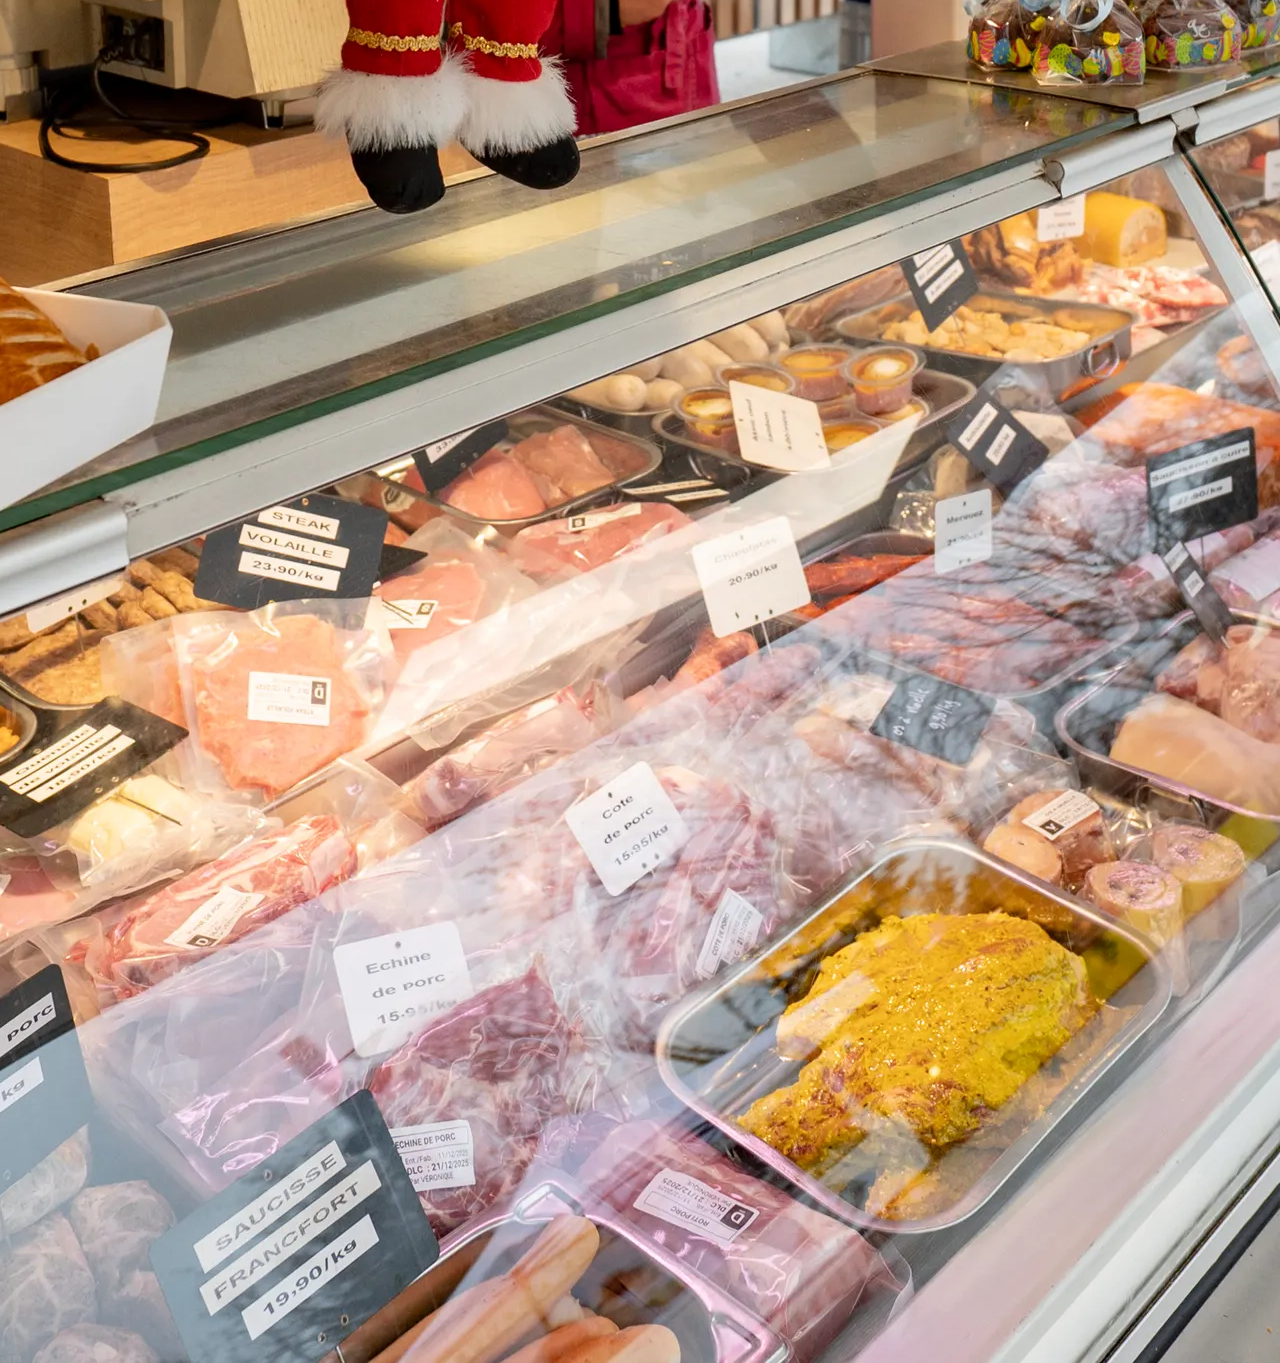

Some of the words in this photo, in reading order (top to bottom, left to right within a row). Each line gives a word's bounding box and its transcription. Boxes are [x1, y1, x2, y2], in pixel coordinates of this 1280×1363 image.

[272, 511, 332, 533] STEAK
[247, 530, 333, 559] VOLAILLE
[602, 793, 634, 820] Cote
[604, 827, 621, 845] de
[624, 805, 655, 831] porc
[365, 950, 432, 975] Echine
[372, 984, 397, 999] de
[402, 972, 446, 992] porc
[7, 1003, 54, 1042] porc
[395, 1137, 423, 1151] ECHINE
[424, 1136, 434, 1145] DE
[435, 1132, 456, 1143] PORC
[431, 1159, 470, 1171] 21/12/2025
[217, 1153, 337, 1252] SAUCISSE
[670, 1205, 690, 1219] PORC
[213, 1181, 359, 1301] FRANCFORT
[263, 1238, 358, 1316] 19,90/kg
